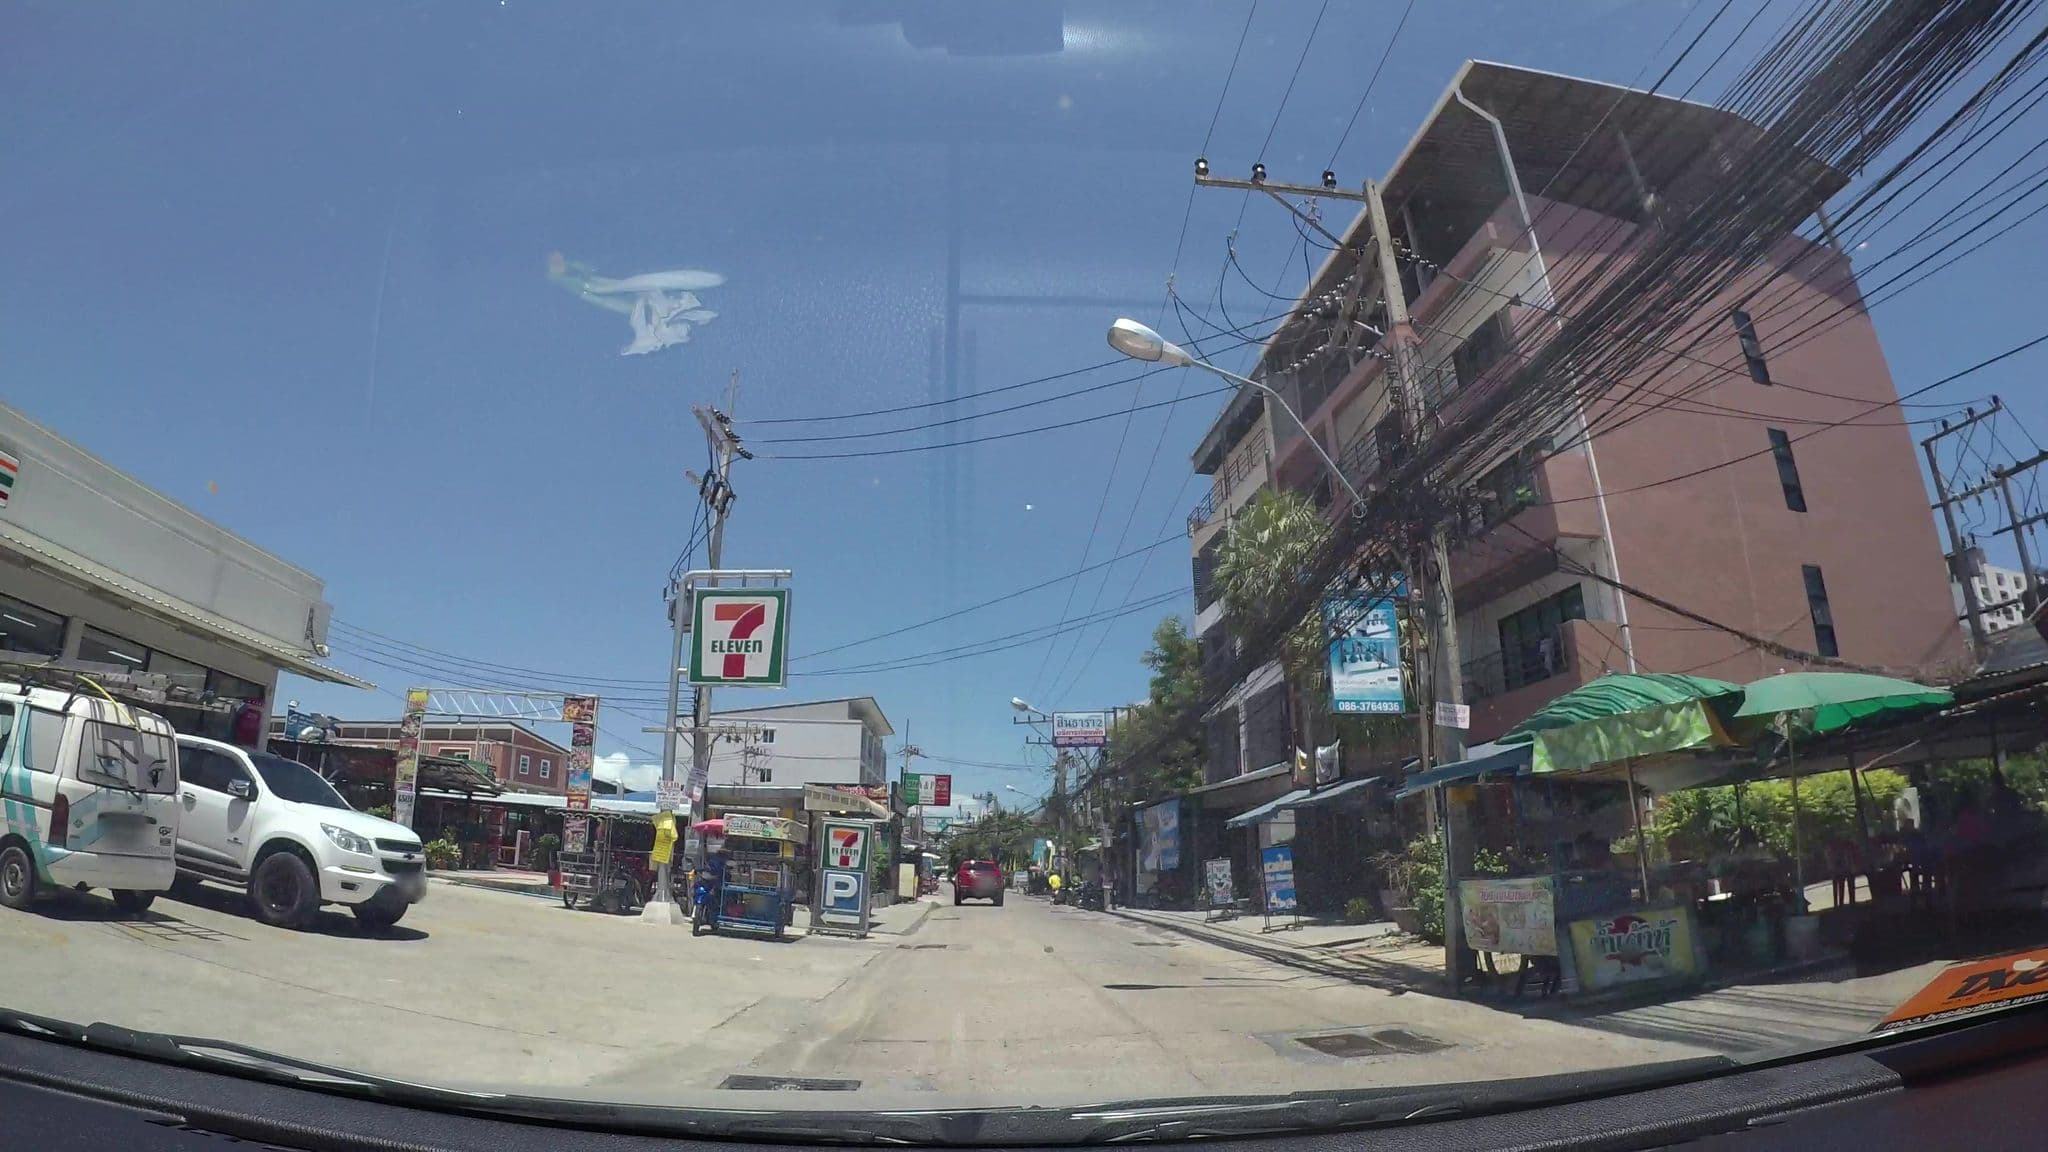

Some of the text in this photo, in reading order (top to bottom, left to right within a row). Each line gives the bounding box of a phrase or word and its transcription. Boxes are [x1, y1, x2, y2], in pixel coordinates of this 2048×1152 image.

[715, 604, 765, 677] 7
[1339, 701, 1400, 711] 086-3764936
[833, 830, 858, 866] 7
[825, 874, 858, 906] P
